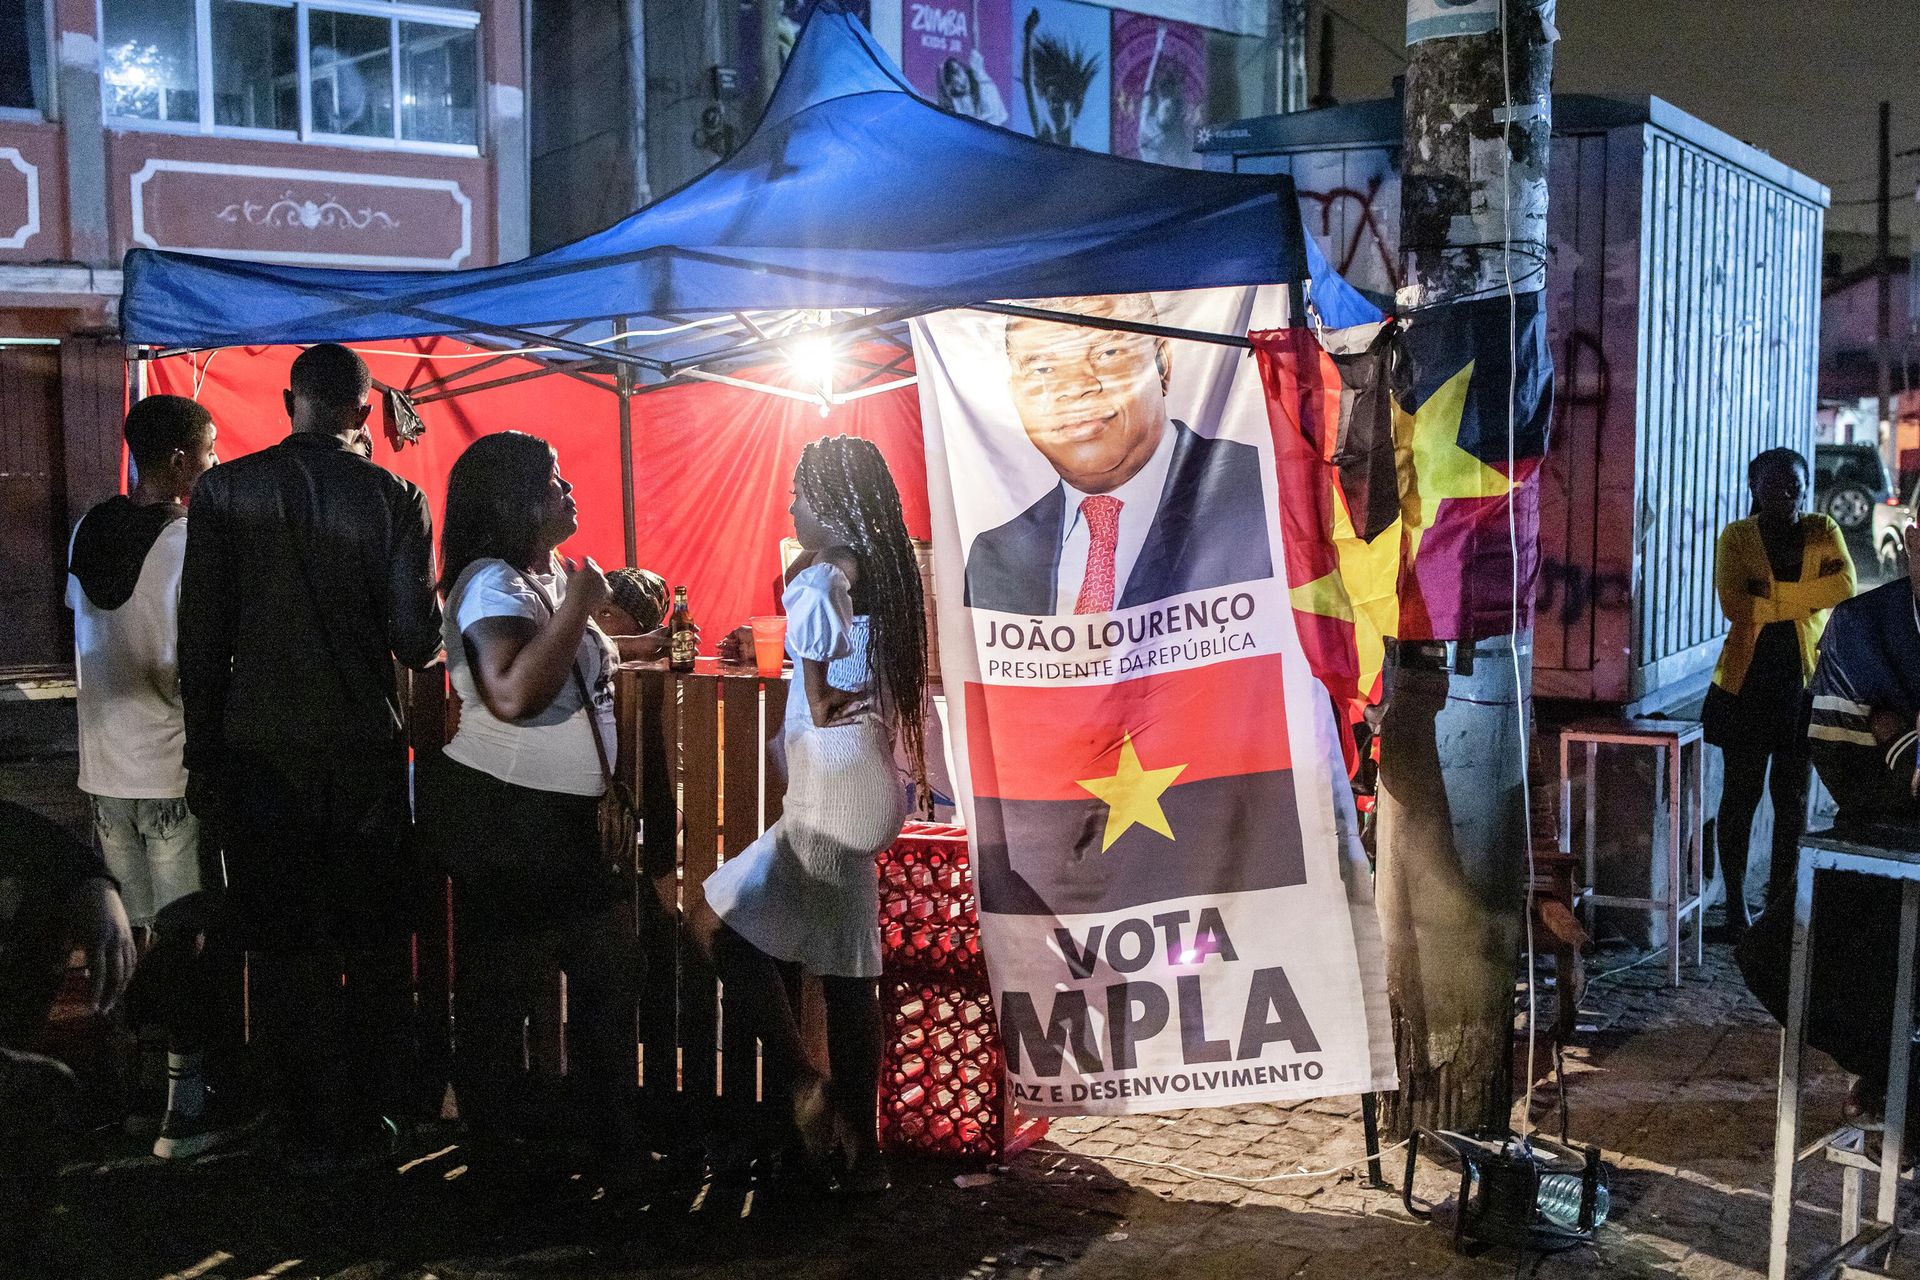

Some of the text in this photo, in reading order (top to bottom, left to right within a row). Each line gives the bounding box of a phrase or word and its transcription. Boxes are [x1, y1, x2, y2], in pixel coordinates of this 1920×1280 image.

[911, 3, 968, 37] ZUMBA
[986, 592, 1255, 652] JOÃO LOURENÇO
[989, 632, 1256, 679] PRESIDENTE DA REPÚBLICA
[1054, 907, 1239, 980] VOTA
[1000, 966, 1322, 1078] MPLA
[1050, 1085, 1064, 1103] E
[1071, 1060, 1324, 1102] DESENVOLVIMENTO
